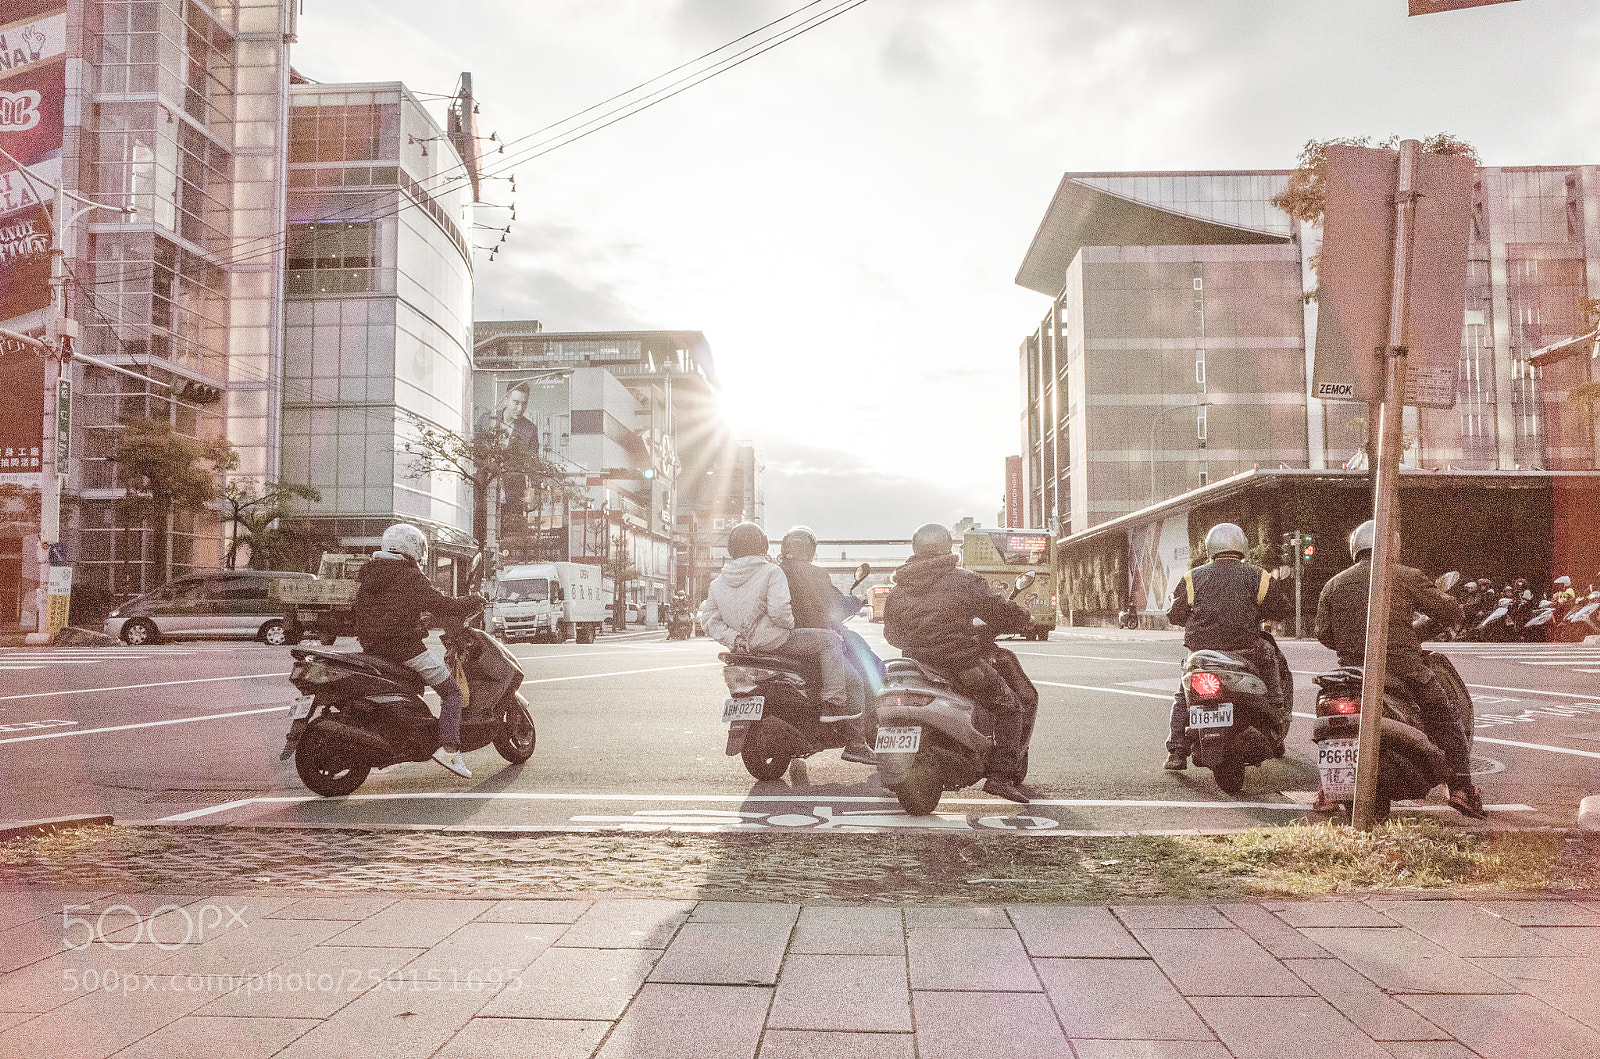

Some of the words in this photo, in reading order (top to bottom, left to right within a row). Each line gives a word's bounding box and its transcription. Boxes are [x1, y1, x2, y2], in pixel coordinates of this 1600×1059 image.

[0, 189, 34, 213] LA
[1319, 384, 1353, 396] ZEMOK
[0, 447, 39, 457] 身工廠
[1190, 710, 1232, 725] 018-MWV
